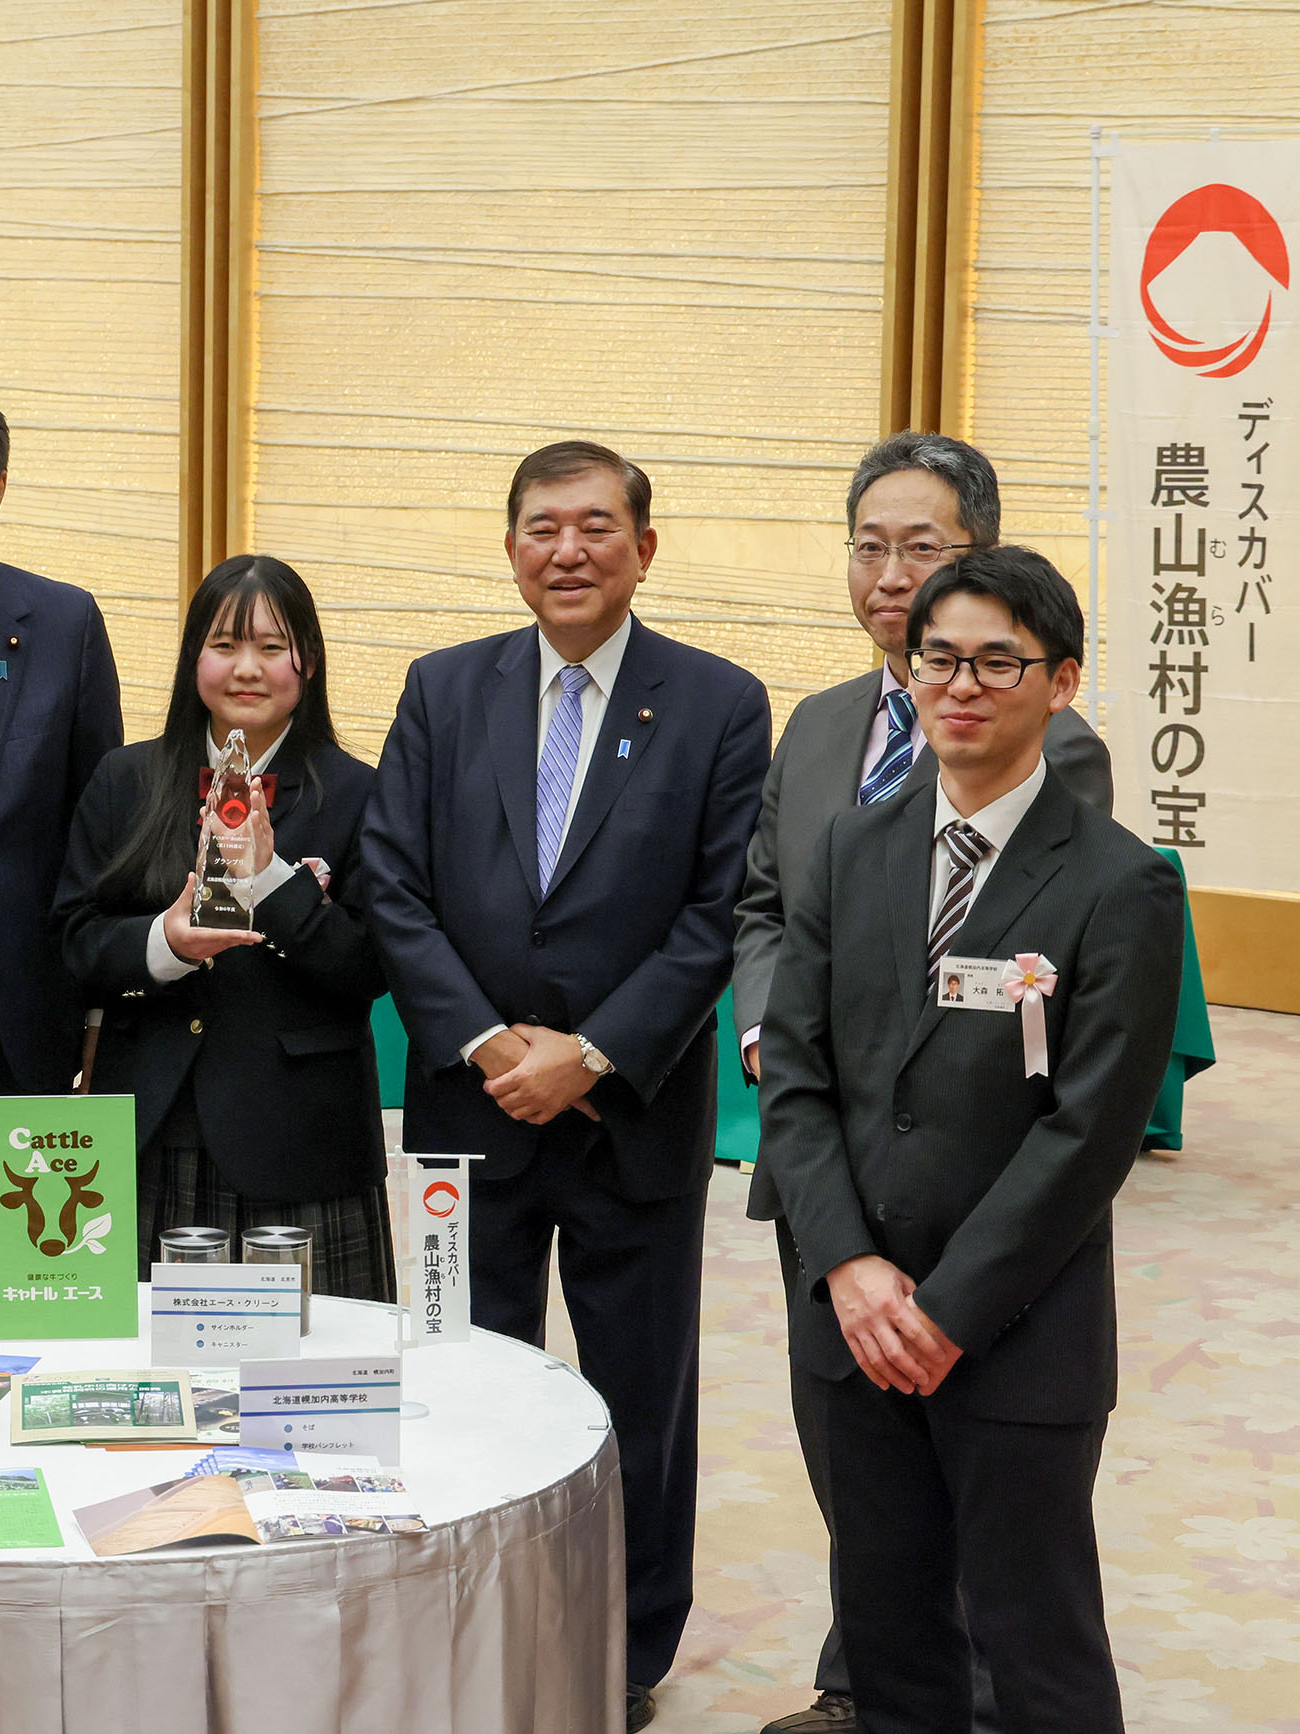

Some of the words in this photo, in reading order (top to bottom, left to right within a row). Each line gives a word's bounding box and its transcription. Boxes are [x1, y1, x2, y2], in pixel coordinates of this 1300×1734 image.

[1235, 397, 1274, 662] ディスカバー
[1148, 442, 1211, 848] 農山漁村の宝
[214, 857, 244, 865] グランプリ
[973, 986, 988, 995] 大森
[9, 1127, 93, 1150] Cattle
[25, 1150, 77, 1173] Ace
[447, 1221, 460, 1287] ディスカバー
[423, 1233, 442, 1334] 農山漁村の宝
[2, 1286, 58, 1301] キャトル
[63, 1286, 103, 1300] エース
[173, 1297, 279, 1308] 株式会社エース・クリーン
[211, 1324, 254, 1332] サインホルダー
[273, 1393, 368, 1406] 北海道幌加内高等学校
[301, 1441, 355, 1450] 学校パンフレット
